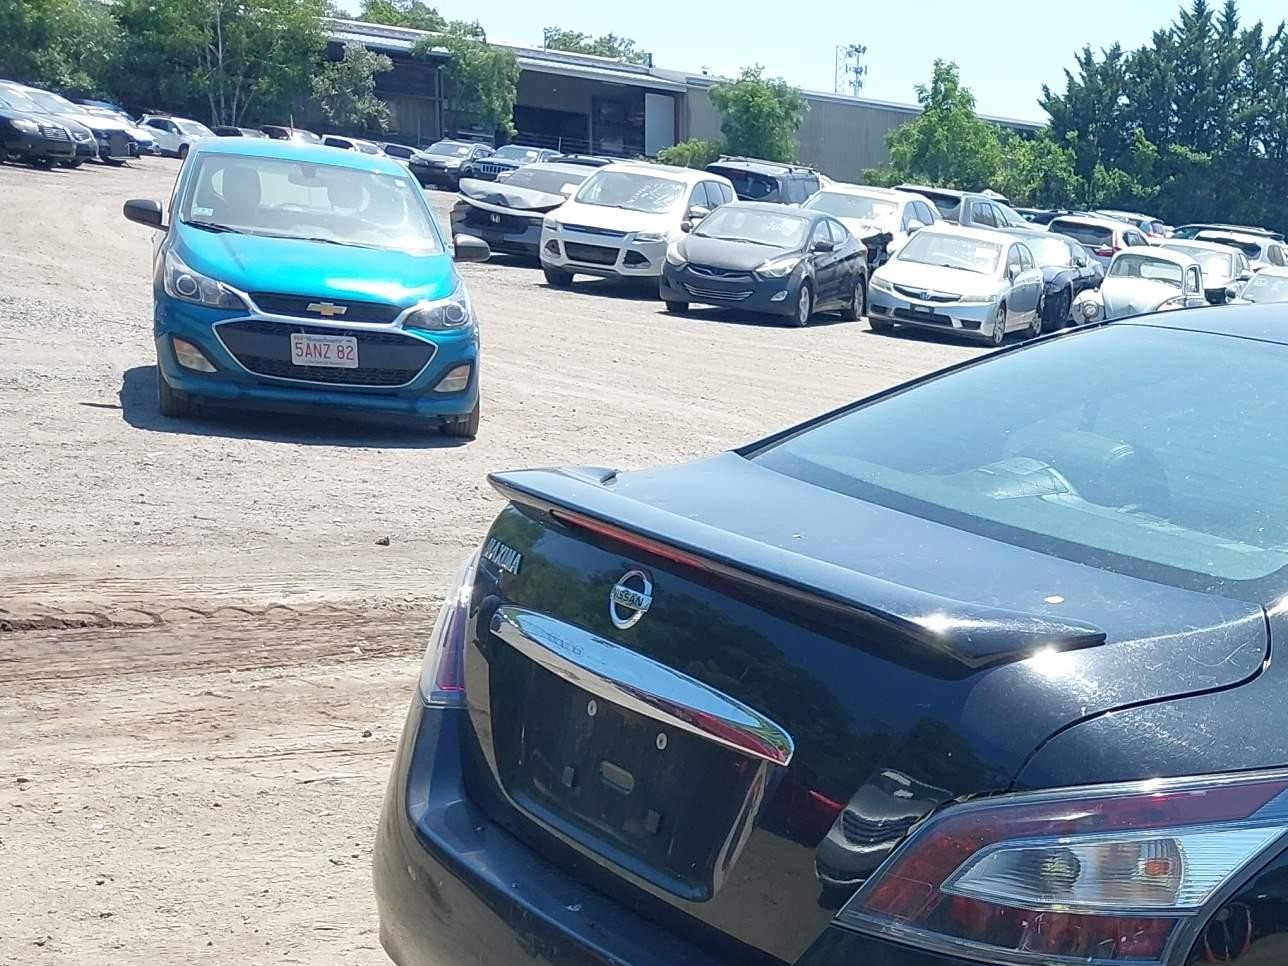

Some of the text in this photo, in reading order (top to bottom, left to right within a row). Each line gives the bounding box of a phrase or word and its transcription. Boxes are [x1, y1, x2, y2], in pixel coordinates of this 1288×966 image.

[295, 342, 354, 360] 5ANZ 82
[614, 587, 645, 607] NISSAN
